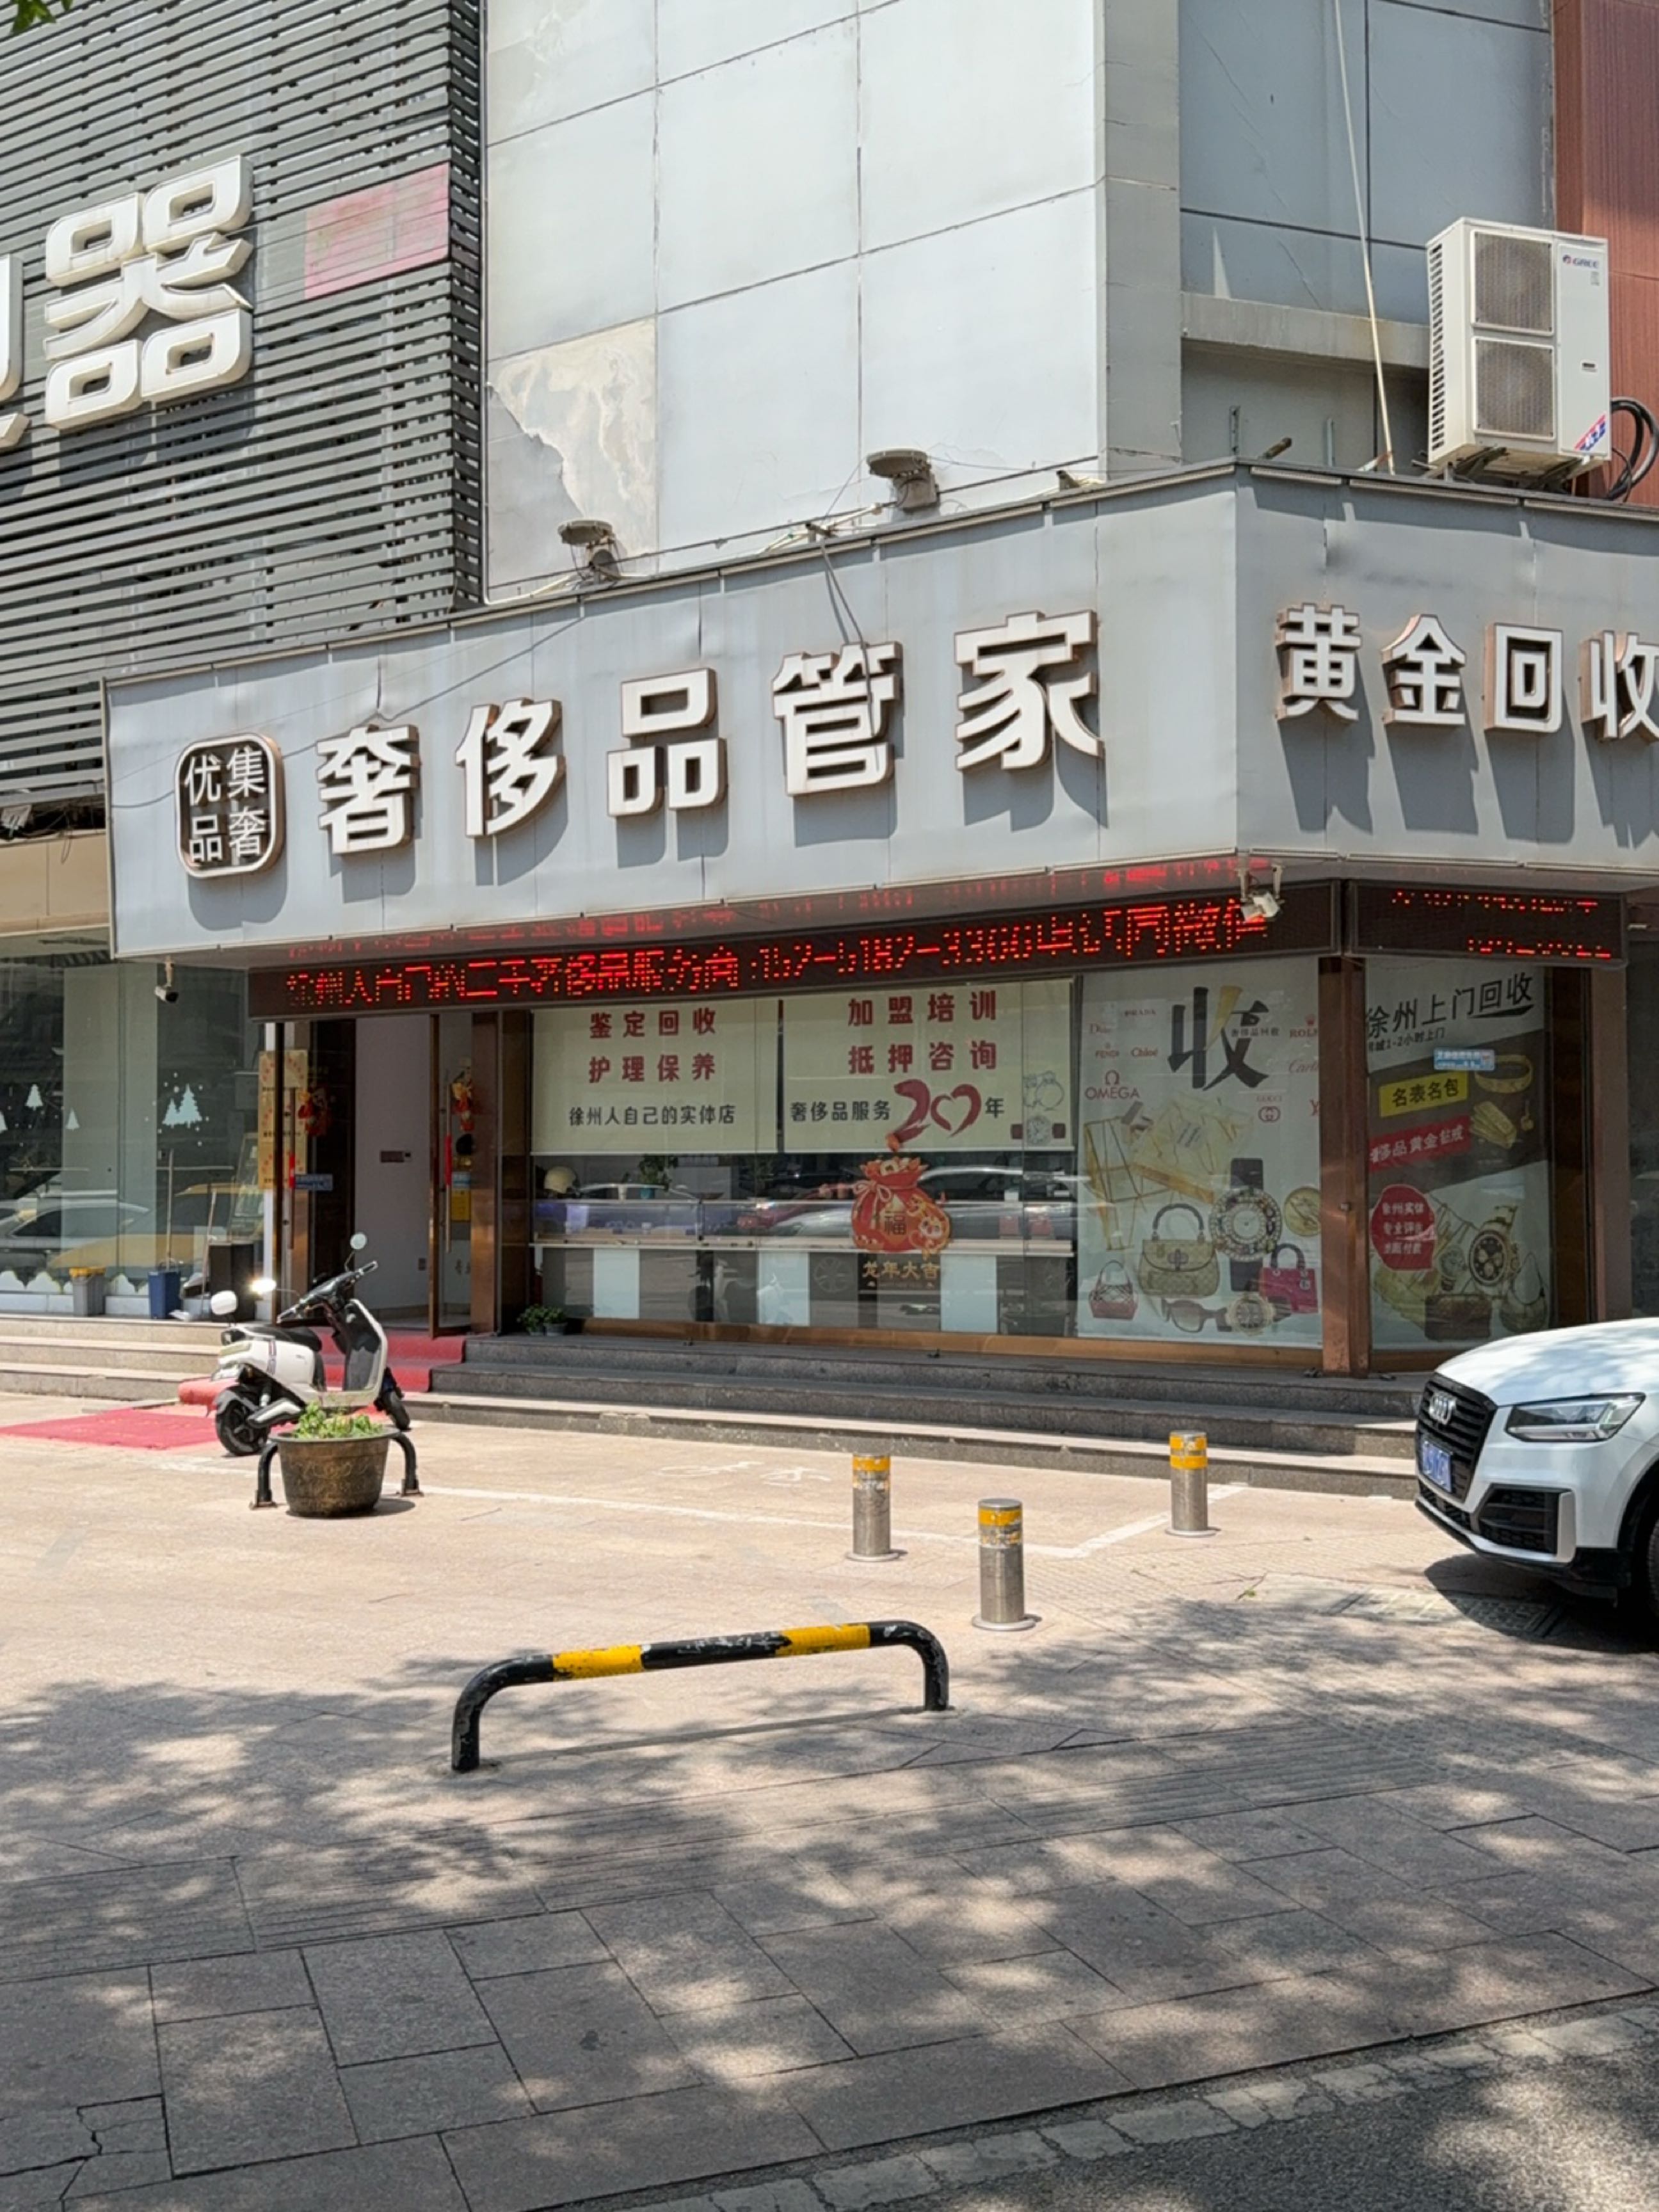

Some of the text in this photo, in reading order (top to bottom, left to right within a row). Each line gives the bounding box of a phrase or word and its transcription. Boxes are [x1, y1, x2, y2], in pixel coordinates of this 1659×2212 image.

[1275, 603, 1659, 745] 黄金回收
[316, 609, 1106, 855] 奢侈品管家
[589, 1007, 716, 1039] 鉴定回收
[847, 990, 997, 1027] 加盟培训
[588, 1053, 716, 1083] 护理保养
[847, 1040, 997, 1075] 抵押咨询
[1084, 1087, 1141, 1100] OMEGA
[1392, 1078, 1459, 1108] 名表名包
[568, 1105, 736, 1126] 徐州人自己的实体店
